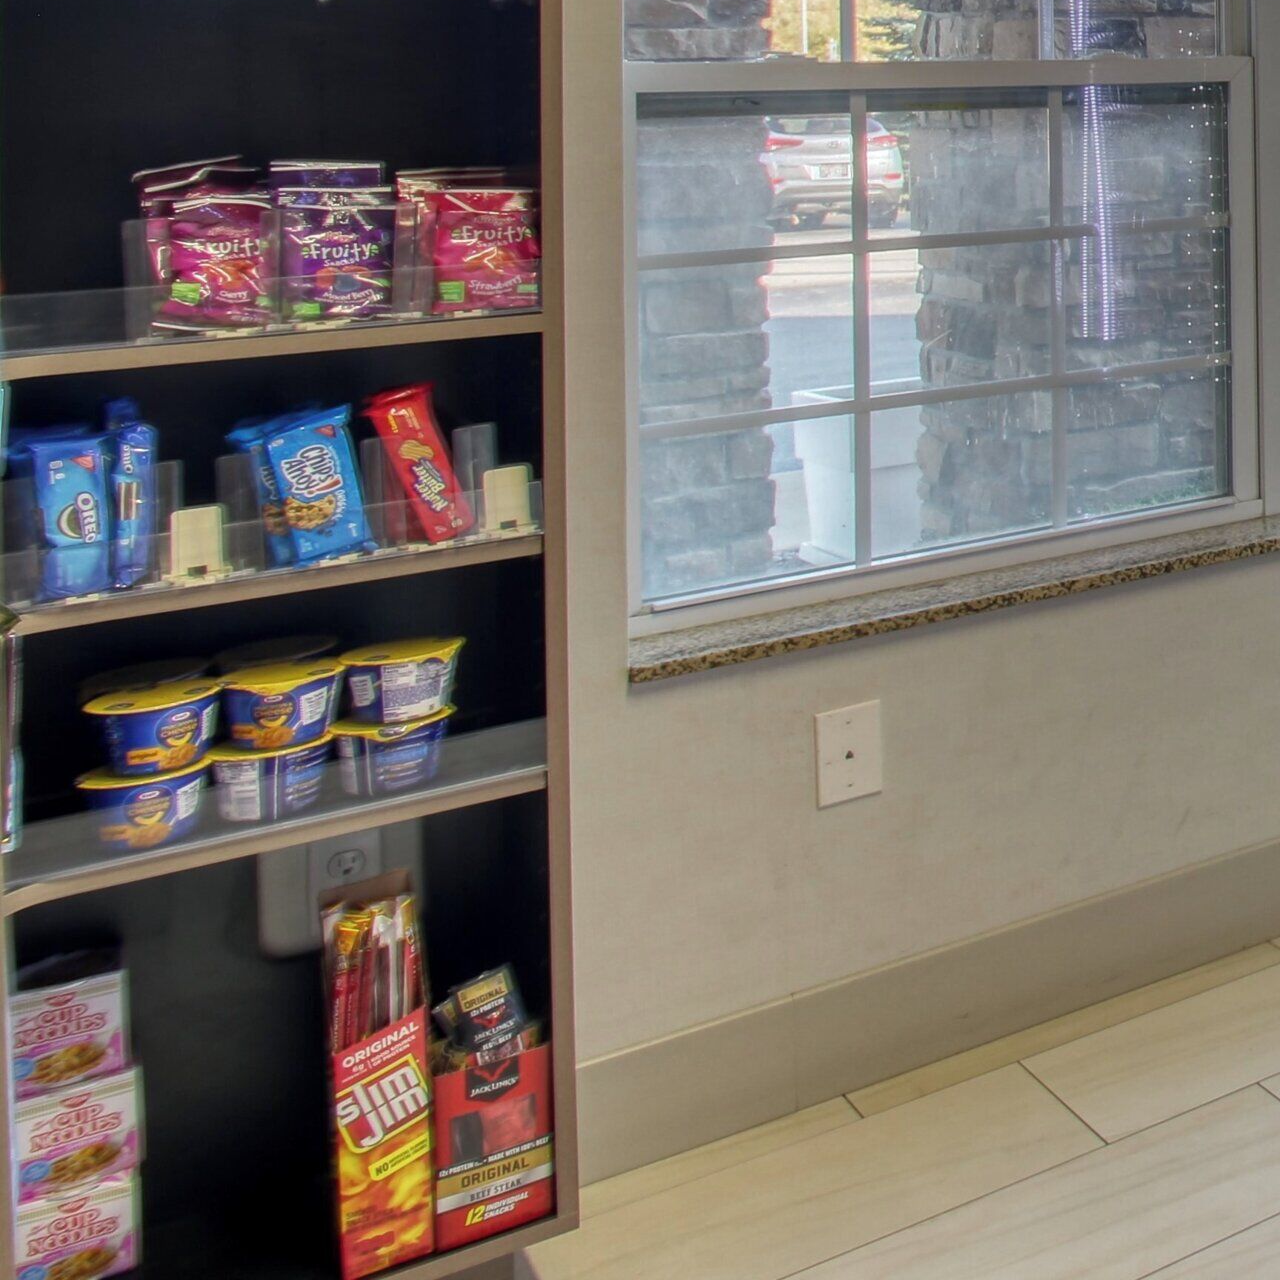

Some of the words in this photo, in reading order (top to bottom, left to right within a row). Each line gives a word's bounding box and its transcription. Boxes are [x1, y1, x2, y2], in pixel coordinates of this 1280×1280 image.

[460, 225, 526, 243] Fruity
[309, 242, 373, 260] Fruity
[468, 275, 523, 290] Strawberry
[218, 290, 248, 299] Cherry
[76, 491, 97, 544] OREO
[463, 986, 505, 1010] ORIGINAL
[342, 1021, 420, 1069] ORIGINAL
[469, 1084, 491, 1098] JACK
[487, 1152, 505, 1163] MADE
[505, 1146, 520, 1157] WITH
[535, 1135, 549, 1147] BEEF
[375, 1161, 390, 1177] NO
[461, 1156, 530, 1189] ORIGINAL
[470, 1187, 492, 1202] BEEF
[494, 1178, 522, 1193] STEAK
[464, 1204, 487, 1227] 12
[485, 1191, 529, 1212] INDIVIDUAL
[483, 1202, 517, 1220] SNACKS
